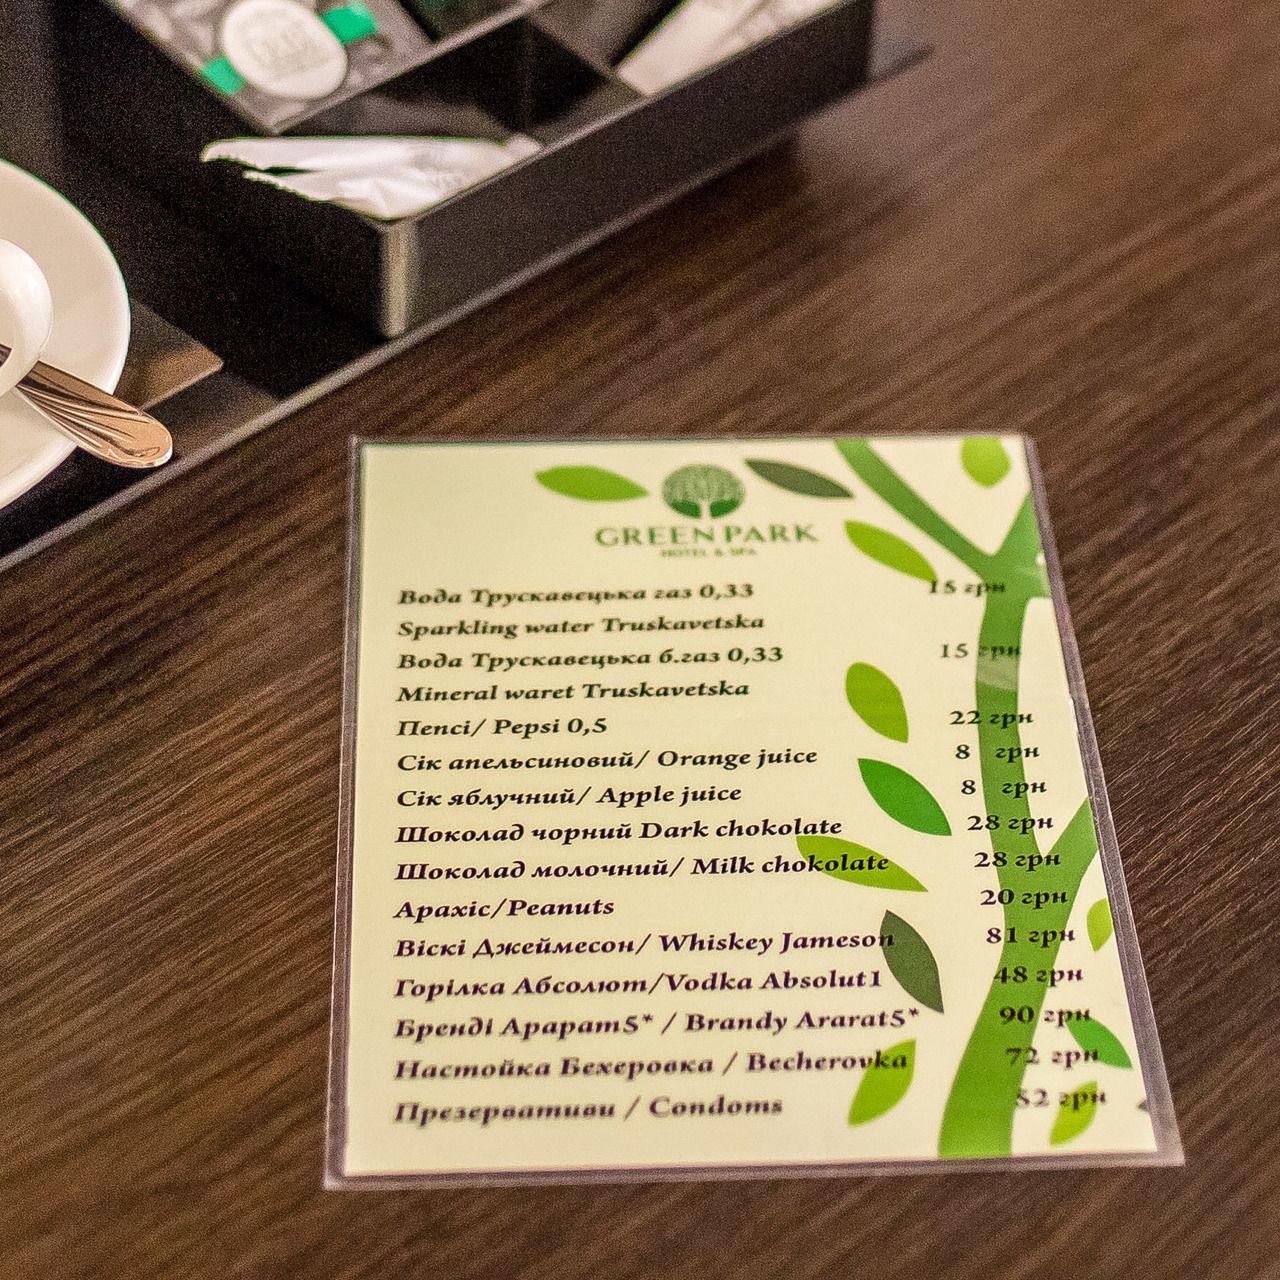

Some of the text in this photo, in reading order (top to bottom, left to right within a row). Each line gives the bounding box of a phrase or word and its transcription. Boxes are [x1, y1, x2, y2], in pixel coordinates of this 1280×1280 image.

[595, 524, 818, 547] GREEN PARK
[398, 580, 1007, 607] Вода Трускавецька газ 0,33 15 грн
[398, 614, 764, 641] Sparkling water Truskavetska
[397, 643, 1021, 672] Вода Трускавецька б.газ 0,33 15 грн
[395, 681, 749, 703] Mineral waret Truskavetska
[397, 710, 1034, 739] Пепсі/ Pepsi 0,5 22 грн
[397, 745, 1040, 772] Сік апельсиновий/ Orange juice 8 грн
[397, 780, 1047, 810] Сік яблучний/ Apple juice 8 грн
[394, 815, 1054, 845] Шоколад чорний Dark chokolate 28 грн
[394, 852, 1062, 881] Шоколад молочний/ Milk chokolate 28 грн
[393, 889, 1068, 924] Арахіс/Peanuts 20 грн
[394, 927, 1076, 959] Віскі Джеймесон/ Whiskey Jameson 81 грн
[394, 979, 506, 1002] Горілка
[512, 971, 752, 997] Абсолют/Vodka
[994, 966, 1028, 984] 48
[1035, 969, 1084, 988] грн
[394, 1017, 493, 1044] Бренді
[684, 1011, 787, 1036] Brandy
[999, 1006, 1035, 1024] 90
[1043, 1009, 1092, 1029] грн
[394, 1059, 551, 1081] Настойка
[559, 1056, 714, 1082] Бехеровка
[746, 1050, 907, 1072] Becherovka
[1005, 1047, 1040, 1065] 72
[1052, 1049, 1100, 1070] грн
[394, 1101, 616, 1128] Презервативи
[648, 1095, 784, 1117] Condoms
[1059, 1092, 1107, 1112] грн
